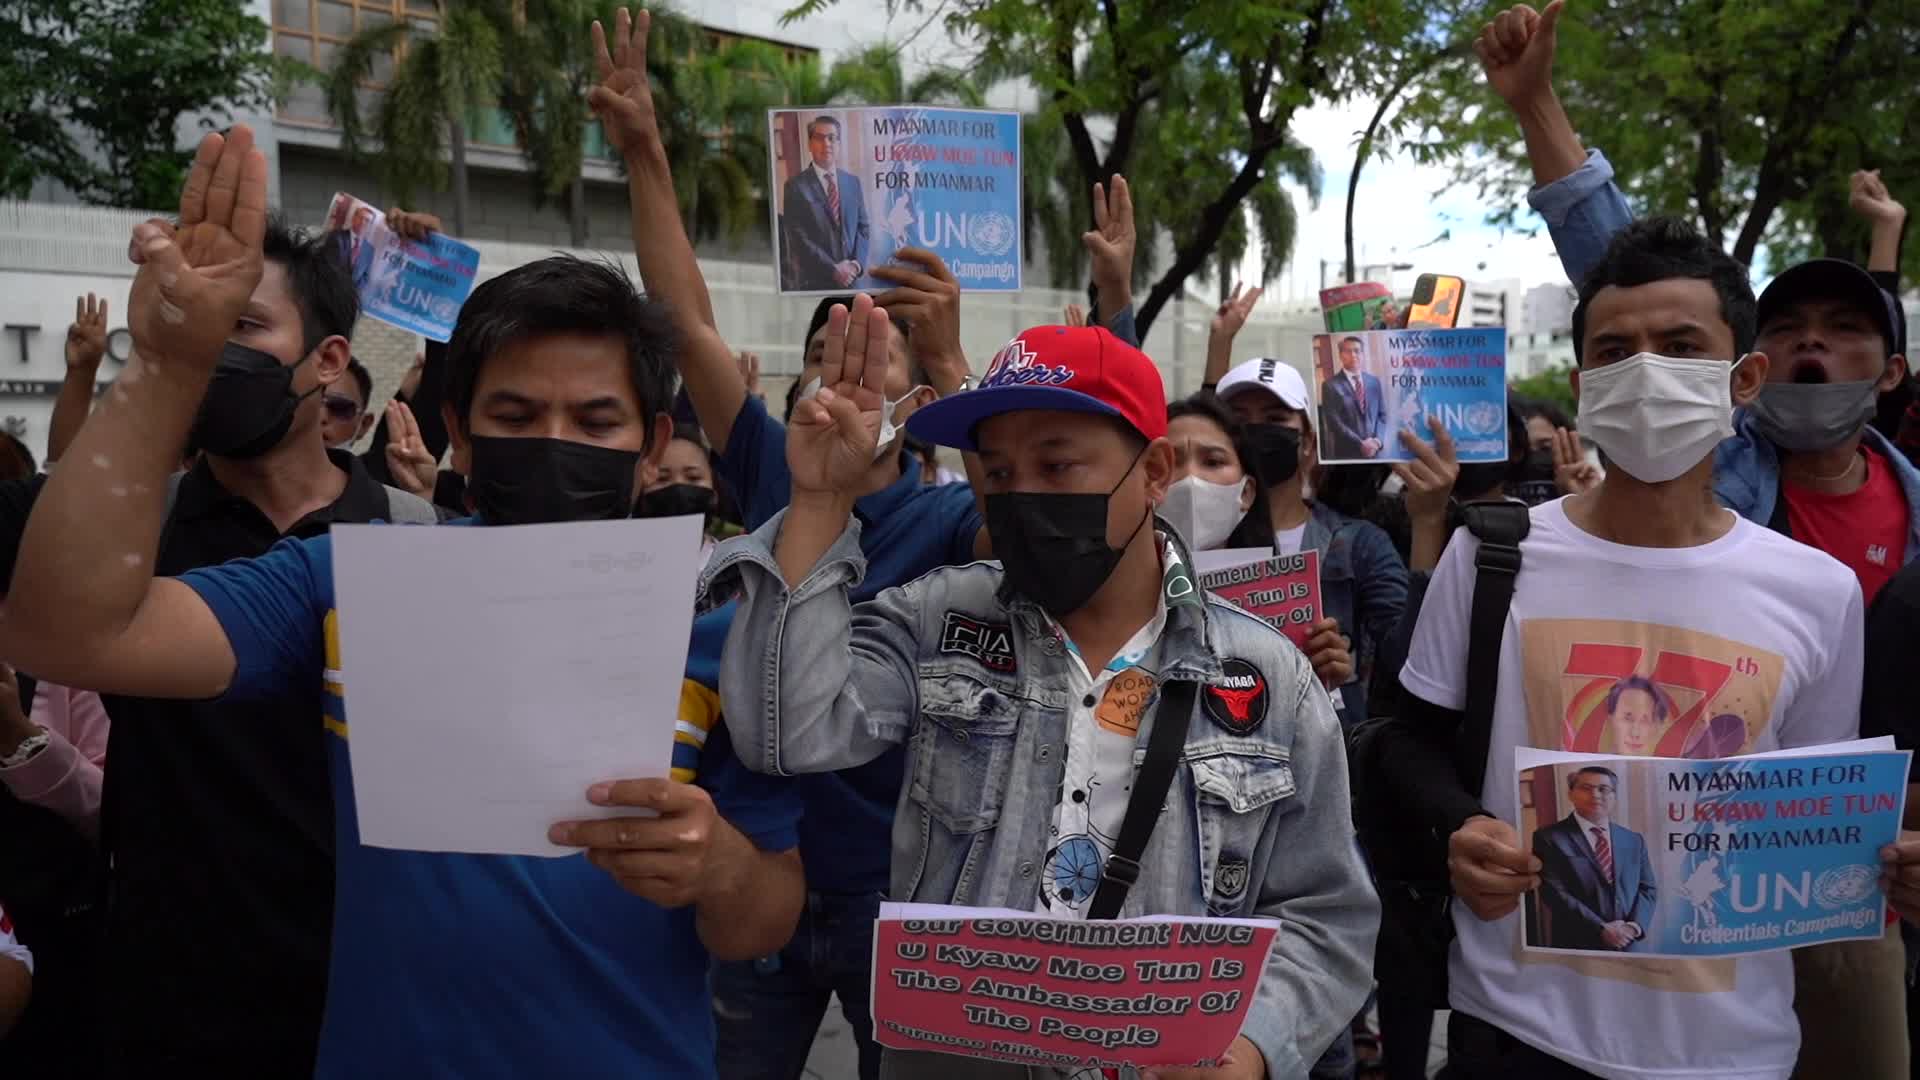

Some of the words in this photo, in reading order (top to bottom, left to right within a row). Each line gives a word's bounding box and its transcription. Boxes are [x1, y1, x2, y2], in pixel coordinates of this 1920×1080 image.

[873, 118, 959, 136] MYANMAR
[962, 122, 995, 139] FOR
[875, 145, 886, 162] U
[890, 144, 936, 161] KYAW
[944, 149, 976, 165] MOE
[984, 151, 1016, 166] TUN
[875, 172, 910, 189] FOR
[914, 172, 996, 193] MYANMAR
[1389, 338, 1454, 349] MYANMAR
[1459, 335, 1487, 347] FOR
[1391, 356, 1399, 368] U
[1402, 355, 1436, 368] KYAW
[1392, 375, 1417, 388] FOR
[1421, 375, 1487, 387] MYANMAR
[1264, 554, 1305, 577] NUG
[1247, 587, 1284, 607] Tun
[1289, 582, 1309, 598] Is
[1290, 605, 1313, 625] Of
[1735, 656, 1760, 676] th
[1668, 768, 1803, 791] MYANMAR
[1811, 764, 1866, 786] FOR
[1668, 802, 1686, 822] U
[1692, 801, 1768, 823] KYAW
[1775, 796, 1834, 819] MOE
[1840, 792, 1896, 816] TUN
[1668, 832, 1721, 852] FOR
[1727, 826, 1862, 851] MYANMAR
[970, 919, 1170, 946] Government
[1177, 923, 1253, 943] NUG
[1680, 920, 1780, 945] Credentials
[898, 943, 926, 960] U
[936, 943, 1040, 971] Kyaw
[1047, 955, 1123, 980] Moe
[1135, 960, 1201, 981] Tun
[1209, 958, 1243, 978] Is
[892, 968, 961, 991] The
[967, 977, 1190, 1014] Ambassador
[1199, 990, 1241, 1012] Of
[963, 1004, 1031, 1030] The
[1039, 1016, 1158, 1048] People
